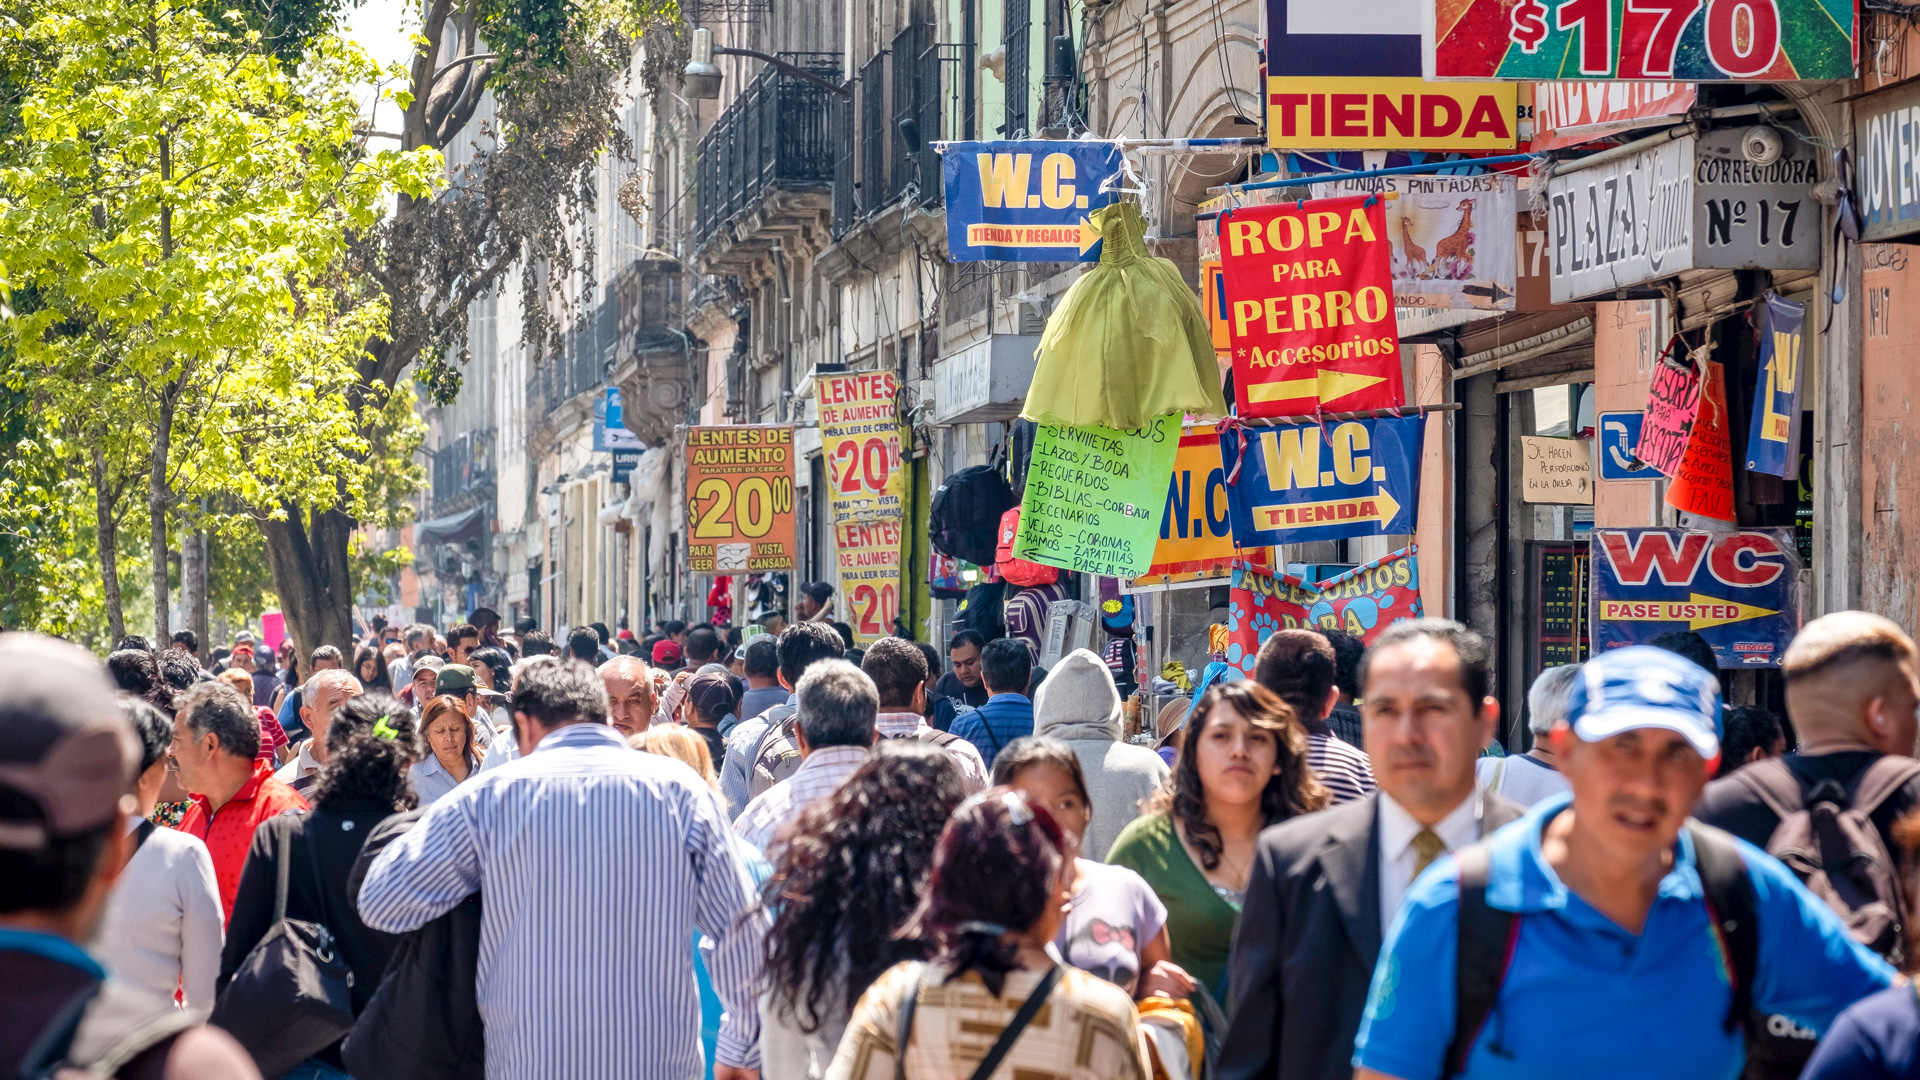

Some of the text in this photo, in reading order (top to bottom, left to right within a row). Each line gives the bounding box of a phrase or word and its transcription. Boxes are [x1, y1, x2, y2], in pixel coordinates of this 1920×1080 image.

[1508, 0, 1782, 77] $170
[1270, 93, 1511, 138] TIENDA
[1698, 156, 1818, 185] CORREGIDORA
[977, 153, 1088, 209] W.C.
[1407, 177, 1493, 194] PINTADAS
[1228, 208, 1377, 257] ROPA
[1552, 169, 1640, 280] PLAZA
[1757, 199, 1801, 248] 17
[972, 228, 1081, 243] TIENDA Y REGALOS
[1272, 258, 1342, 283] PARA
[1233, 285, 1389, 338] PERRO
[819, 373, 896, 405] LENTES
[822, 404, 896, 424] DE AUMENTO
[688, 428, 791, 446] LENTES DE
[824, 423, 899, 437] PARA LEER DE CERCA
[692, 447, 786, 465] AUMENTO
[1260, 422, 1386, 491] W.C.
[1527, 439, 1572, 460] SE HACEN
[1089, 454, 1129, 479] BODA
[1541, 461, 1590, 474] PERFORACIONES
[1529, 478, 1538, 489] EN
[1541, 479, 1549, 488] LA
[833, 501, 850, 510] PARA
[877, 496, 899, 505] VISTA
[1265, 500, 1380, 526] TIENDA
[835, 521, 900, 549] LENTES
[689, 545, 714, 556] PARA
[757, 543, 784, 554] VISTA
[690, 559, 713, 571] LEER
[749, 557, 792, 570] CANSADA
[840, 551, 899, 567] DE AUMENTO
[1073, 556, 1104, 573] PASE
[1105, 564, 1117, 576] AL
[1597, 531, 1785, 588] WC
[842, 572, 858, 580] PARA
[860, 570, 879, 579] LEER
[1239, 556, 1413, 608] ACCESORIOS
[1607, 603, 1740, 619] PASE USTED
